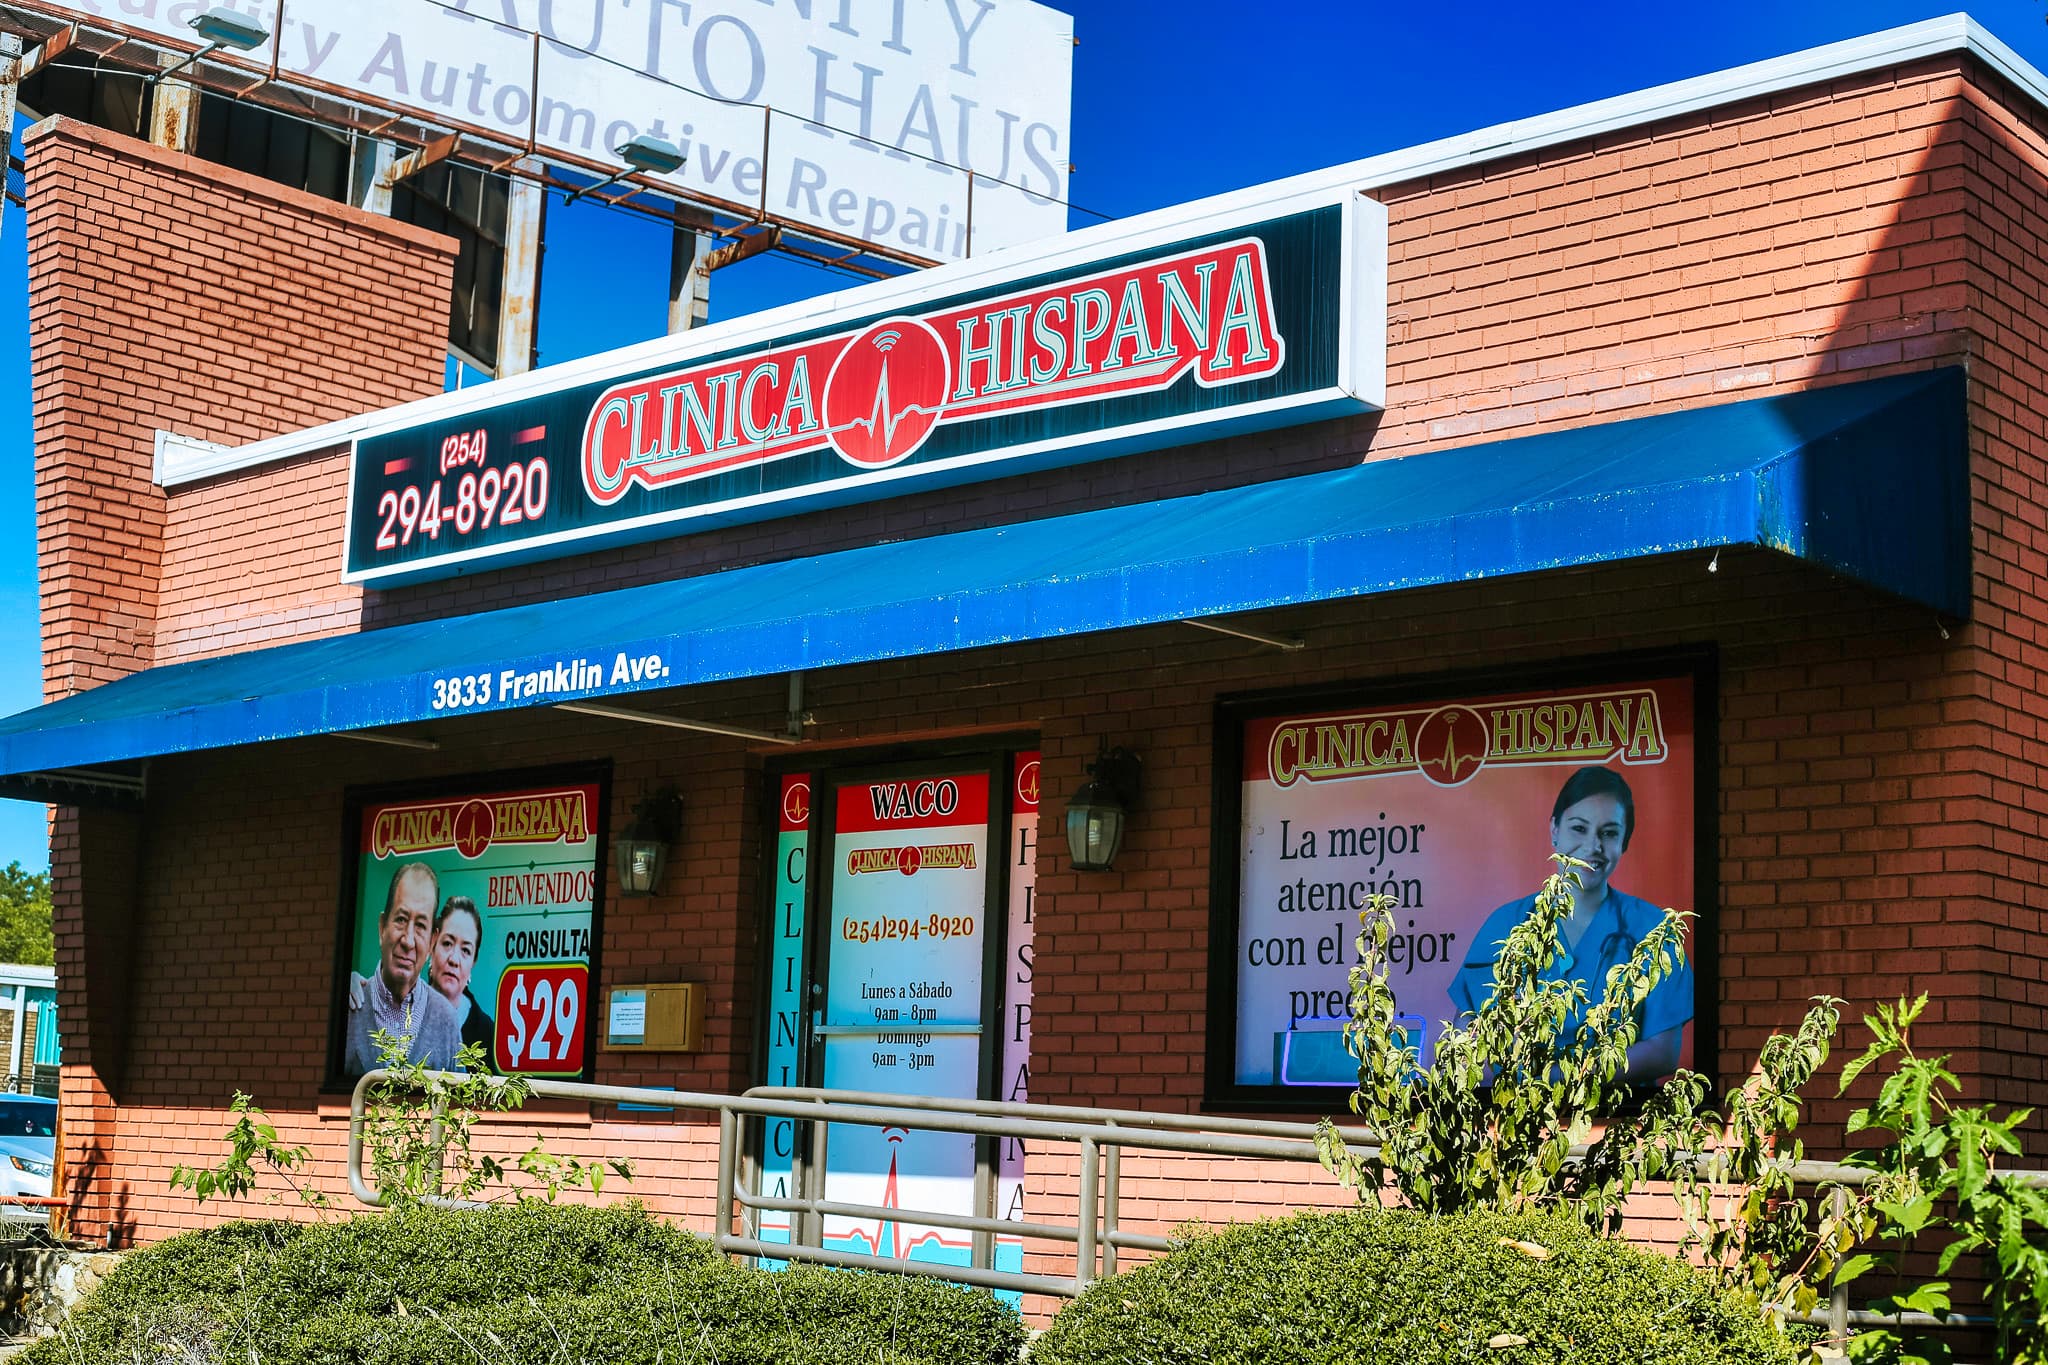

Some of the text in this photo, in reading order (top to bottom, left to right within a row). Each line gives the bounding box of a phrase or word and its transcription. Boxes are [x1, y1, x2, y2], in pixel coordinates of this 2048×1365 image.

[803, 45, 1061, 206] HAUS
[785, 157, 976, 258] Repair
[591, 252, 1271, 492] CLINICA HISPANA
[440, 428, 488, 475] (254)
[375, 456, 549, 551] 294-8920
[432, 651, 671, 711] 3833 Franklin Ave.
[1272, 695, 1662, 783] CLINICA HISPANA
[870, 780, 959, 820] WACO
[374, 796, 587, 857] CLINICA HISPANA
[1279, 811, 1426, 867] La mejor
[848, 845, 977, 875] CLINICA HISPANA
[487, 870, 595, 907] BIENVENIDOS
[1278, 866, 1424, 913] atención
[505, 928, 591, 960] CONSULTA
[843, 914, 974, 944] (254)294-8920
[1248, 936, 1307, 967] con
[1317, 922, 1345, 965] el
[861, 981, 953, 999] Lunes a Sábado
[1289, 987, 1405, 1030] pre.
[507, 973, 579, 1068] $29
[874, 1007, 899, 1023] 9am
[911, 1004, 937, 1025] 8pm
[872, 1052, 896, 1069] 9am
[908, 1052, 935, 1071] 3pm
[876, 1033, 931, 1048] Domingo
